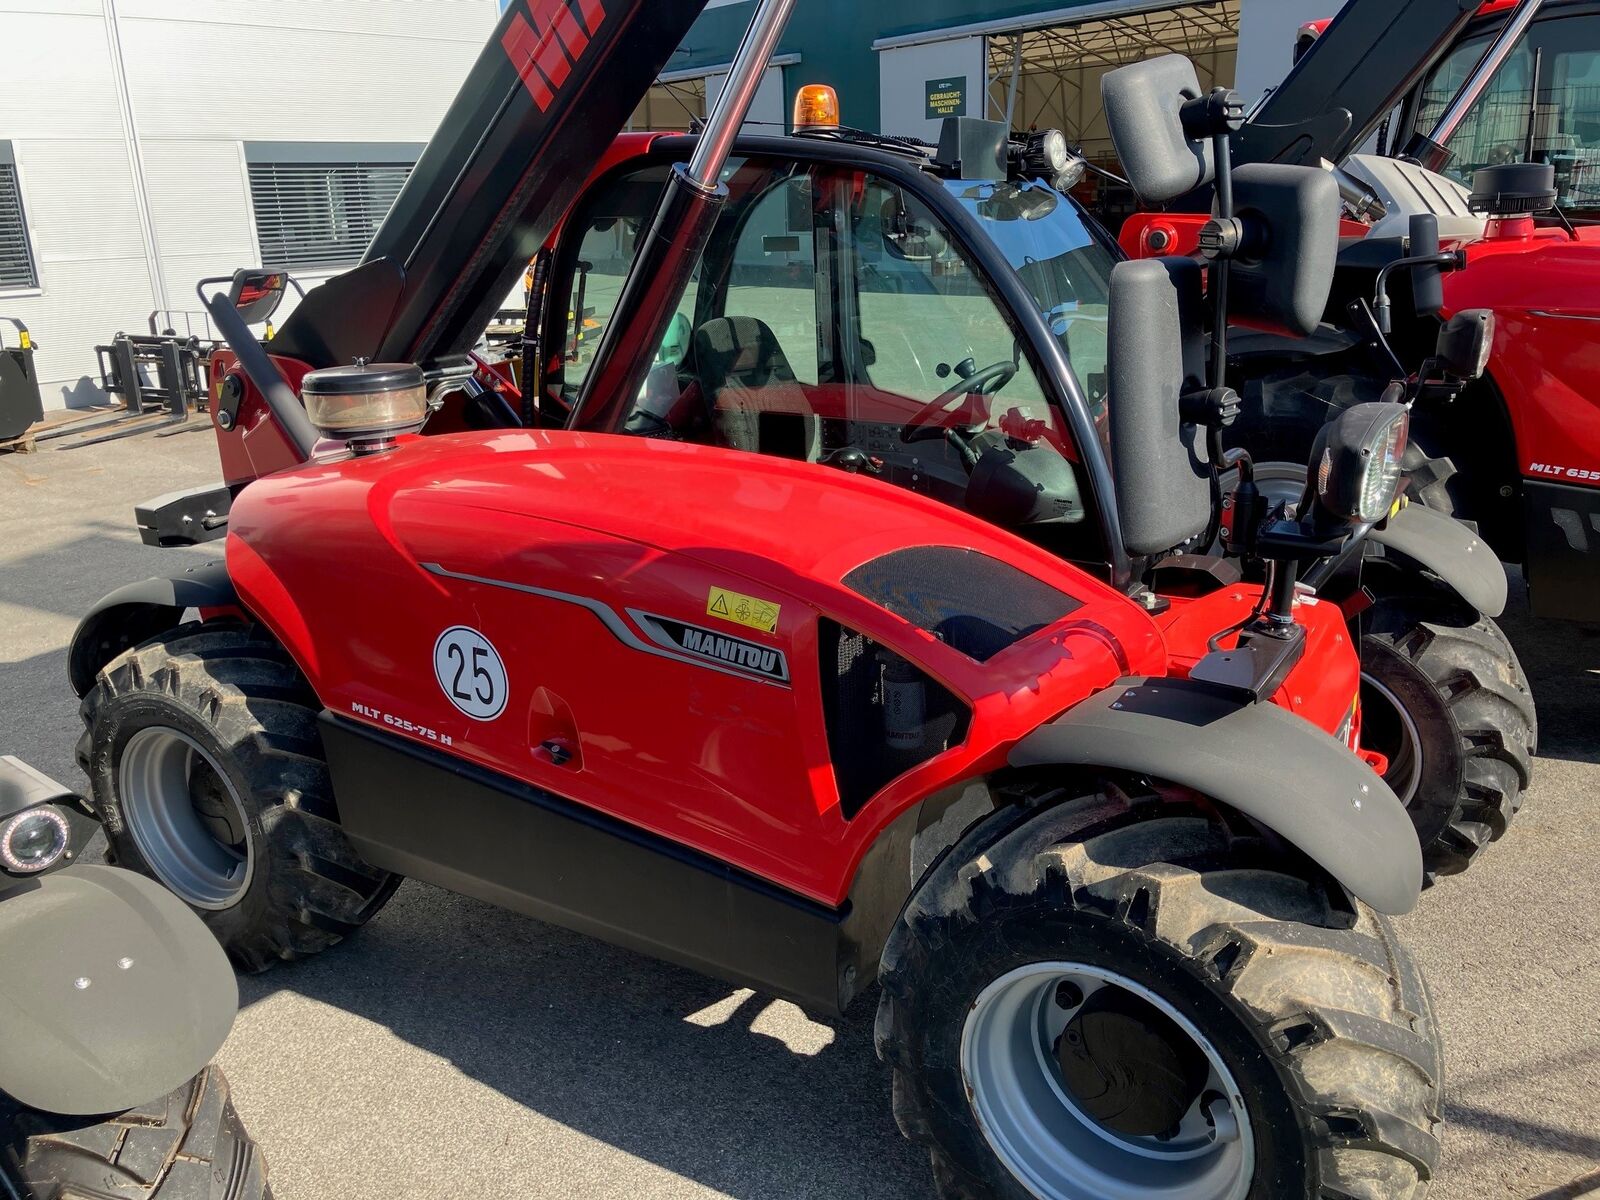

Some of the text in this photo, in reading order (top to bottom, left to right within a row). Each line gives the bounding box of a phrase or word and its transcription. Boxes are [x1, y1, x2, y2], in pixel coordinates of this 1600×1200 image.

[1529, 462, 1565, 474] MLT
[682, 628, 777, 672] MANITOU
[448, 643, 494, 705] 25
[352, 702, 452, 746] MLT 625-75 H
